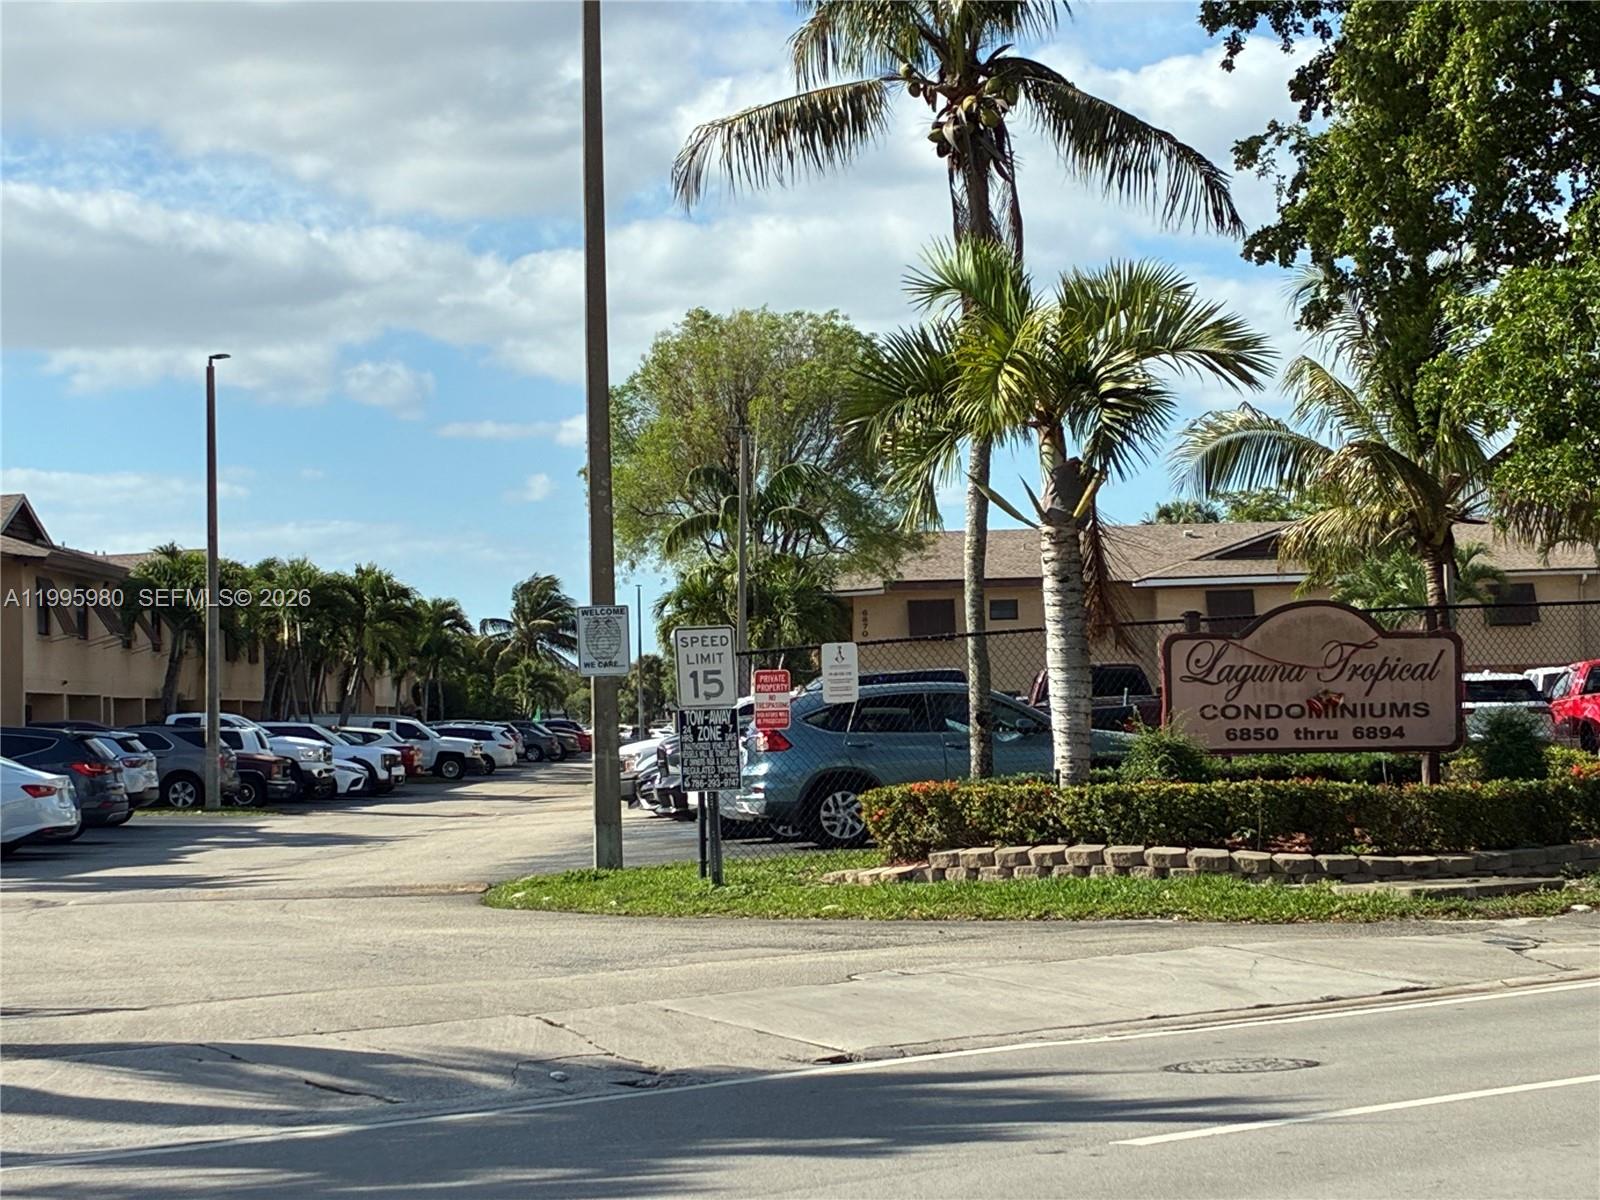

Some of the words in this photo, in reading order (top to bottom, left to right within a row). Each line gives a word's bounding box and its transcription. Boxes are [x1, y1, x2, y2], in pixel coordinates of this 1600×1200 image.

[581, 608, 625, 616] WELCOME
[680, 635, 729, 648] SPEED
[686, 652, 724, 665] LIMIT
[1179, 640, 1309, 702] Laguna
[1316, 640, 1446, 697] Tropical
[689, 670, 724, 699] 15
[759, 674, 786, 683] PRIVATE
[756, 683, 788, 692] PROPERTY
[684, 710, 731, 725] TOW-AWAY
[1200, 701, 1431, 721] CONDOMINIUMS
[682, 725, 691, 734] 24
[697, 726, 721, 741] ZONE
[1225, 727, 1279, 742] 6850
[1294, 726, 1339, 741] thru
[1352, 725, 1406, 740] 6894
